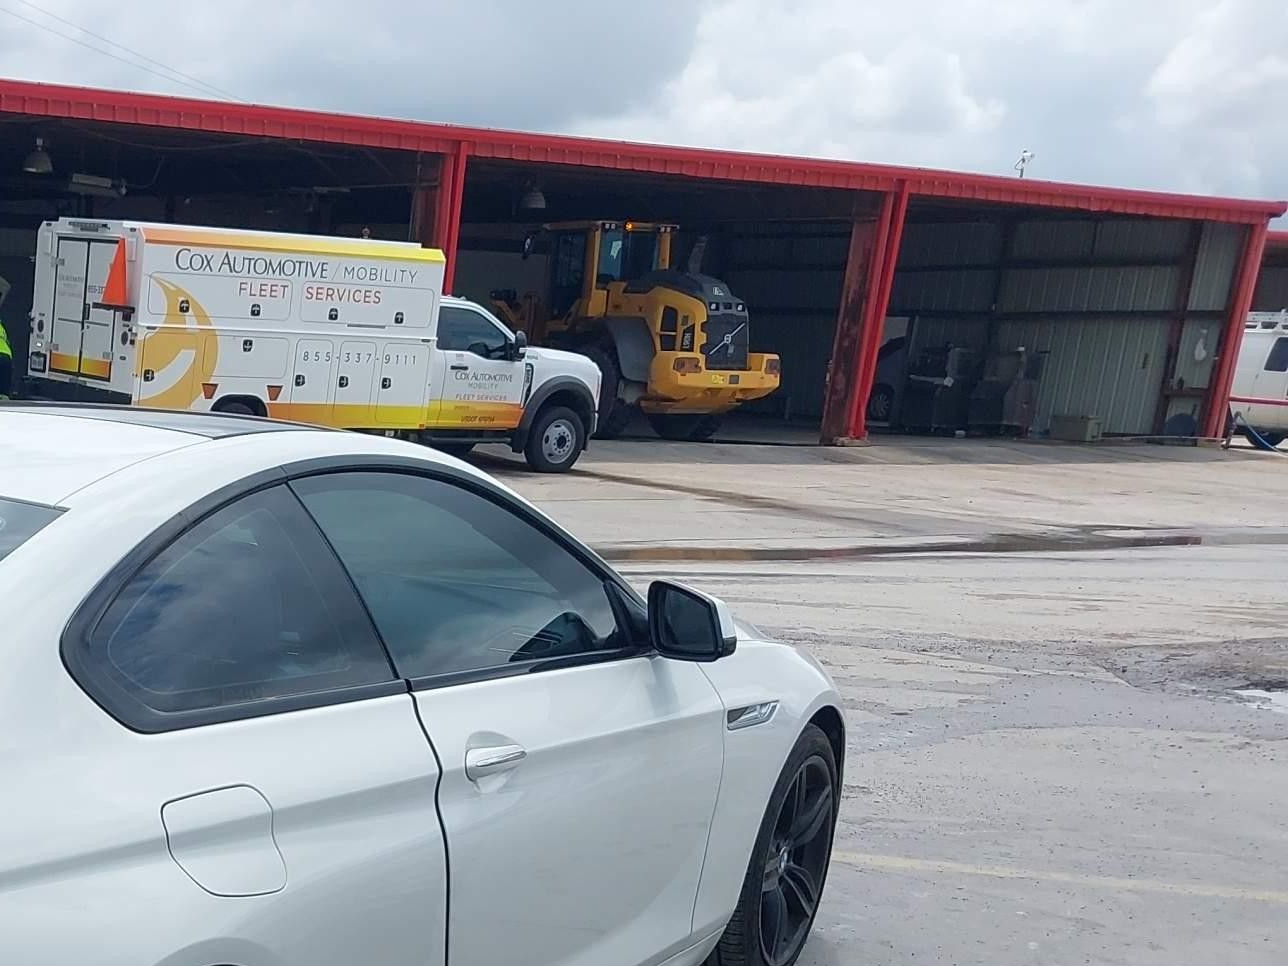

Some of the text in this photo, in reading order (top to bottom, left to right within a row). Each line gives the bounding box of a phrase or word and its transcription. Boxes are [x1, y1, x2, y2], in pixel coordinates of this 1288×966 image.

[175, 248, 214, 273] COX
[218, 251, 329, 279] AUTOMOTIVE
[344, 265, 418, 284] MOBILITY
[238, 282, 381, 304] FLEET SERVICES
[471, 371, 513, 383] AUTOMOTIVE
